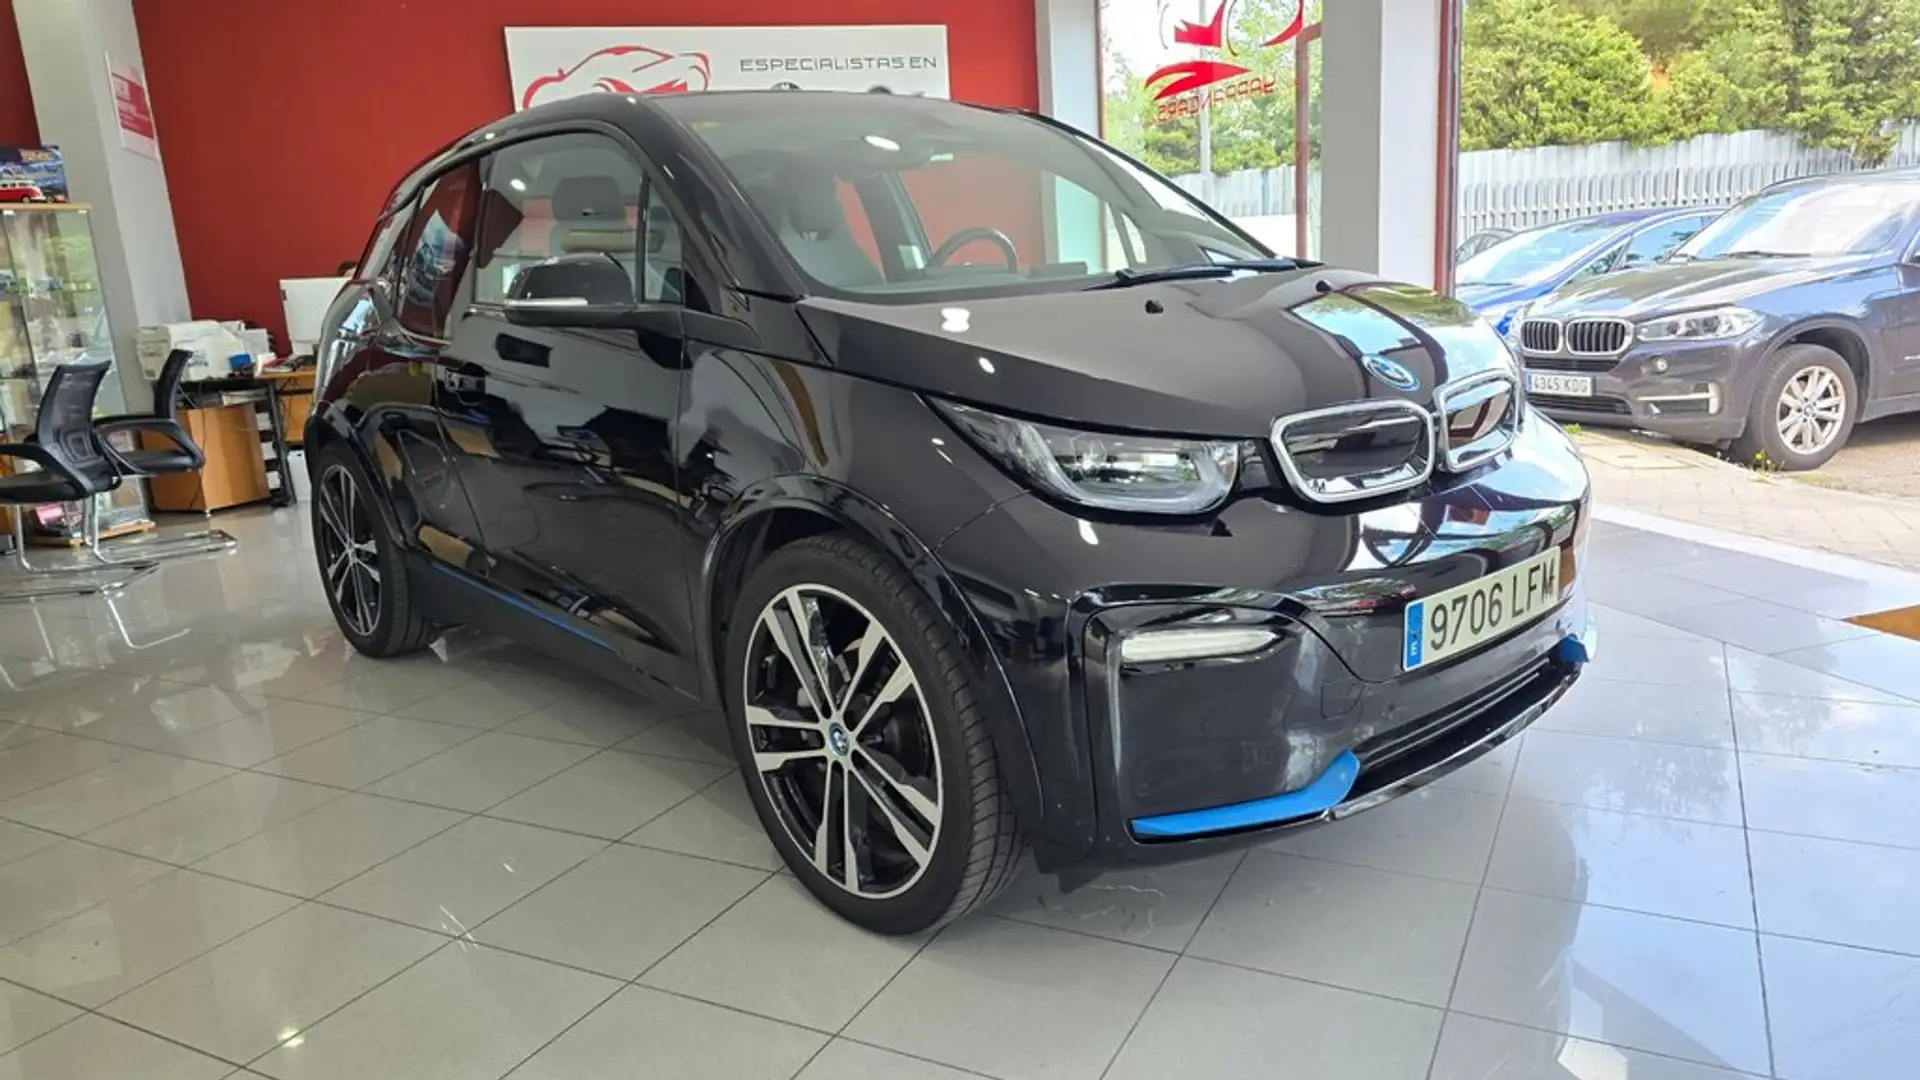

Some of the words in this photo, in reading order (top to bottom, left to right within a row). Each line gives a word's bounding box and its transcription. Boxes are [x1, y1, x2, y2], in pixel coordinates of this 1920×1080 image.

[740, 57, 904, 71] ESPECIALISTAS
[909, 56, 937, 69] EN
[1430, 583, 1503, 650] 9706
[1511, 557, 1556, 618] LFM
